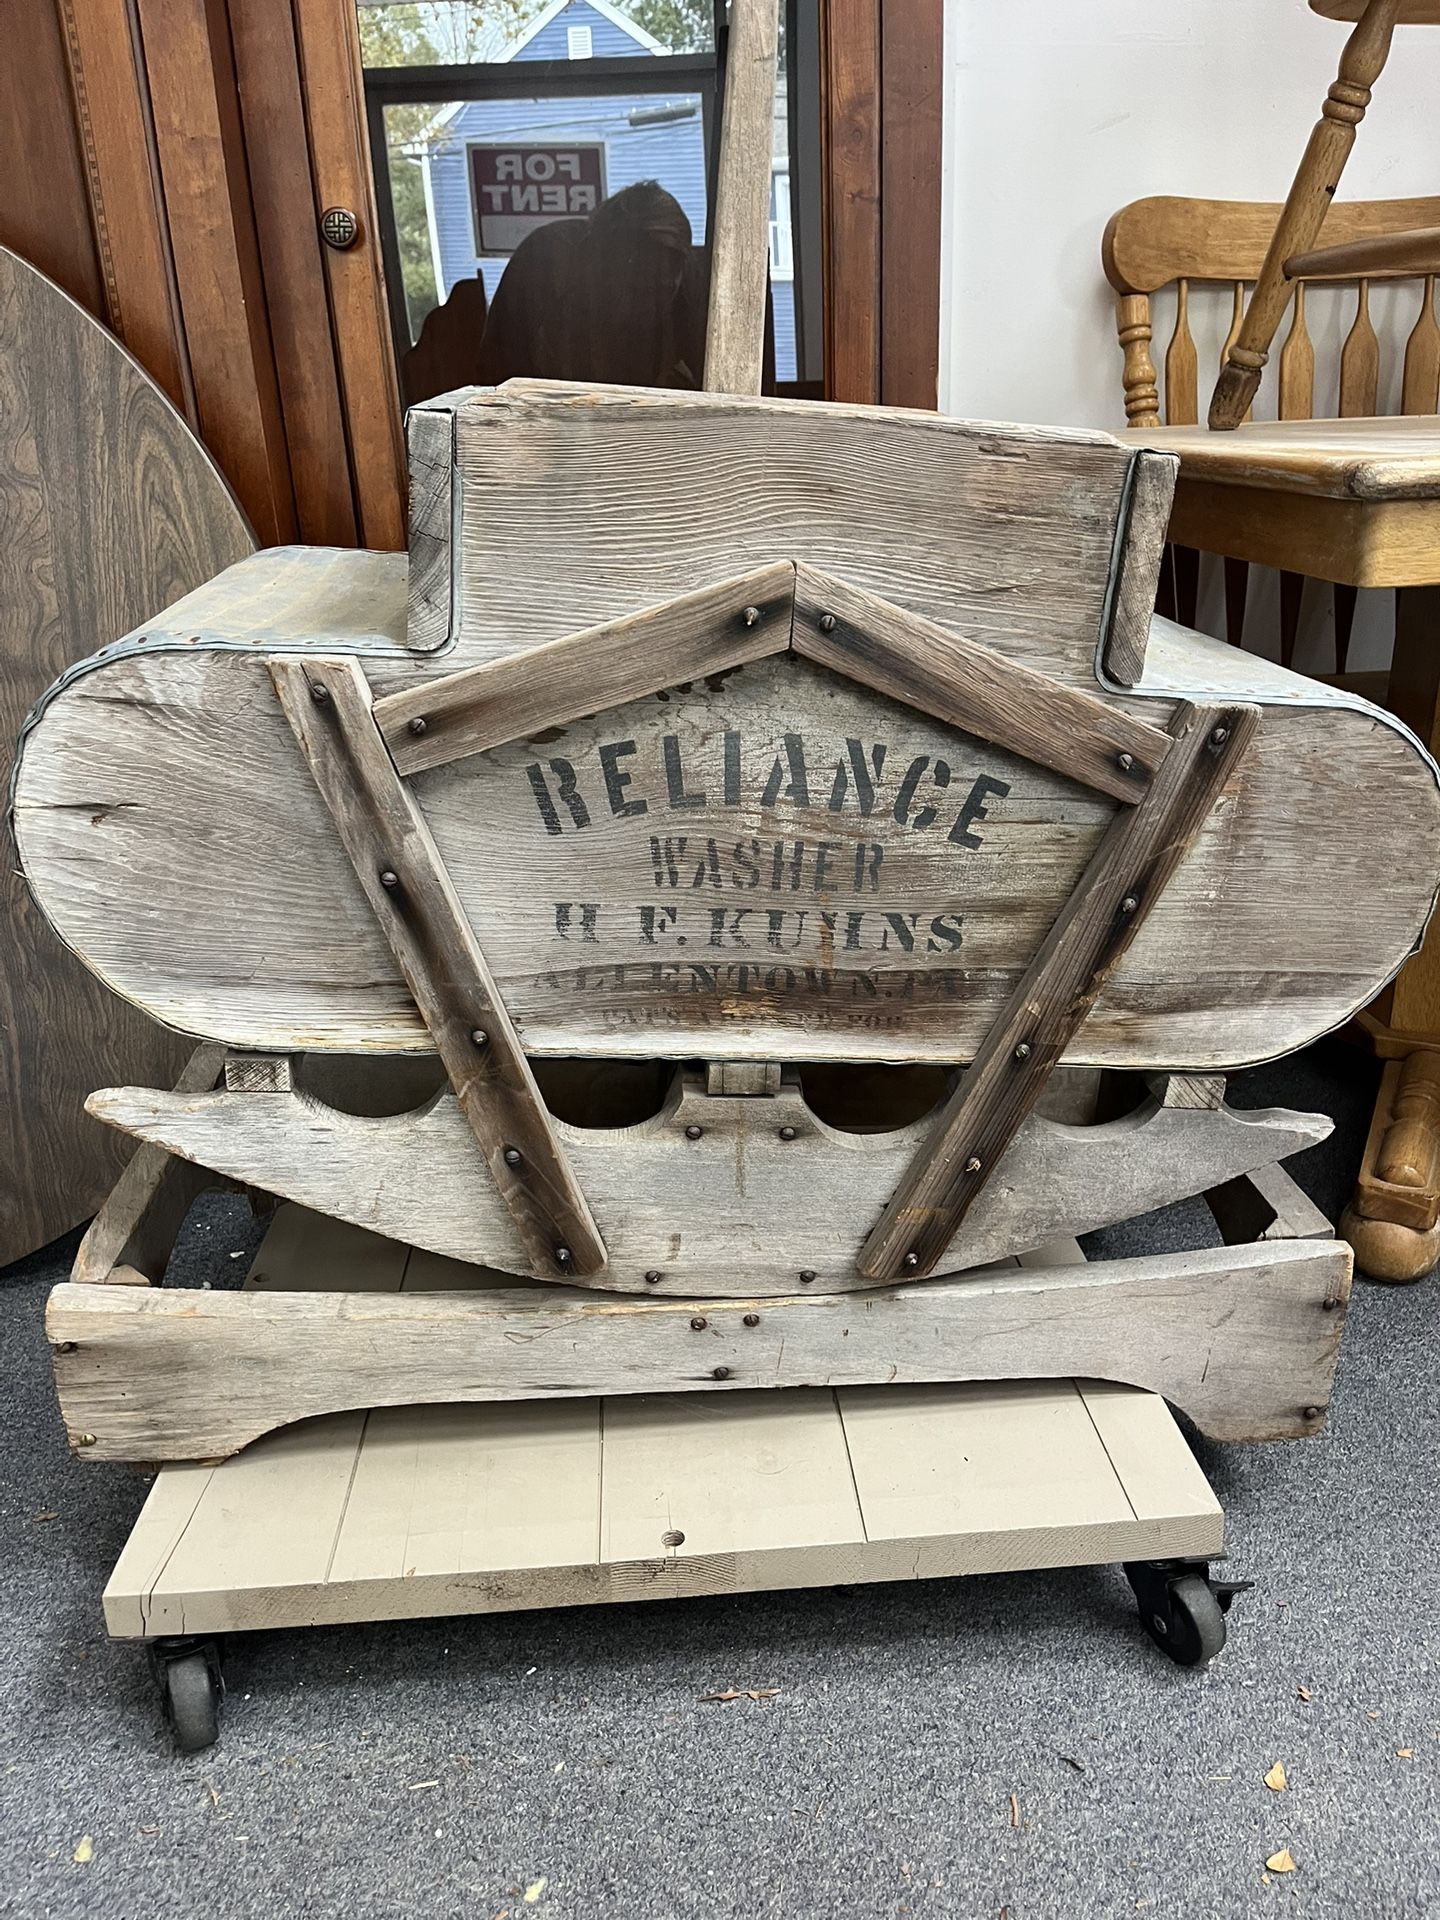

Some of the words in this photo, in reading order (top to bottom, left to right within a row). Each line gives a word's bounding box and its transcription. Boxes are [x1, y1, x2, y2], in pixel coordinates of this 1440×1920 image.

[526, 730, 1011, 851] RELIANCE
[649, 835, 885, 892] WASHER
[707, 907, 964, 953] KUHNS
